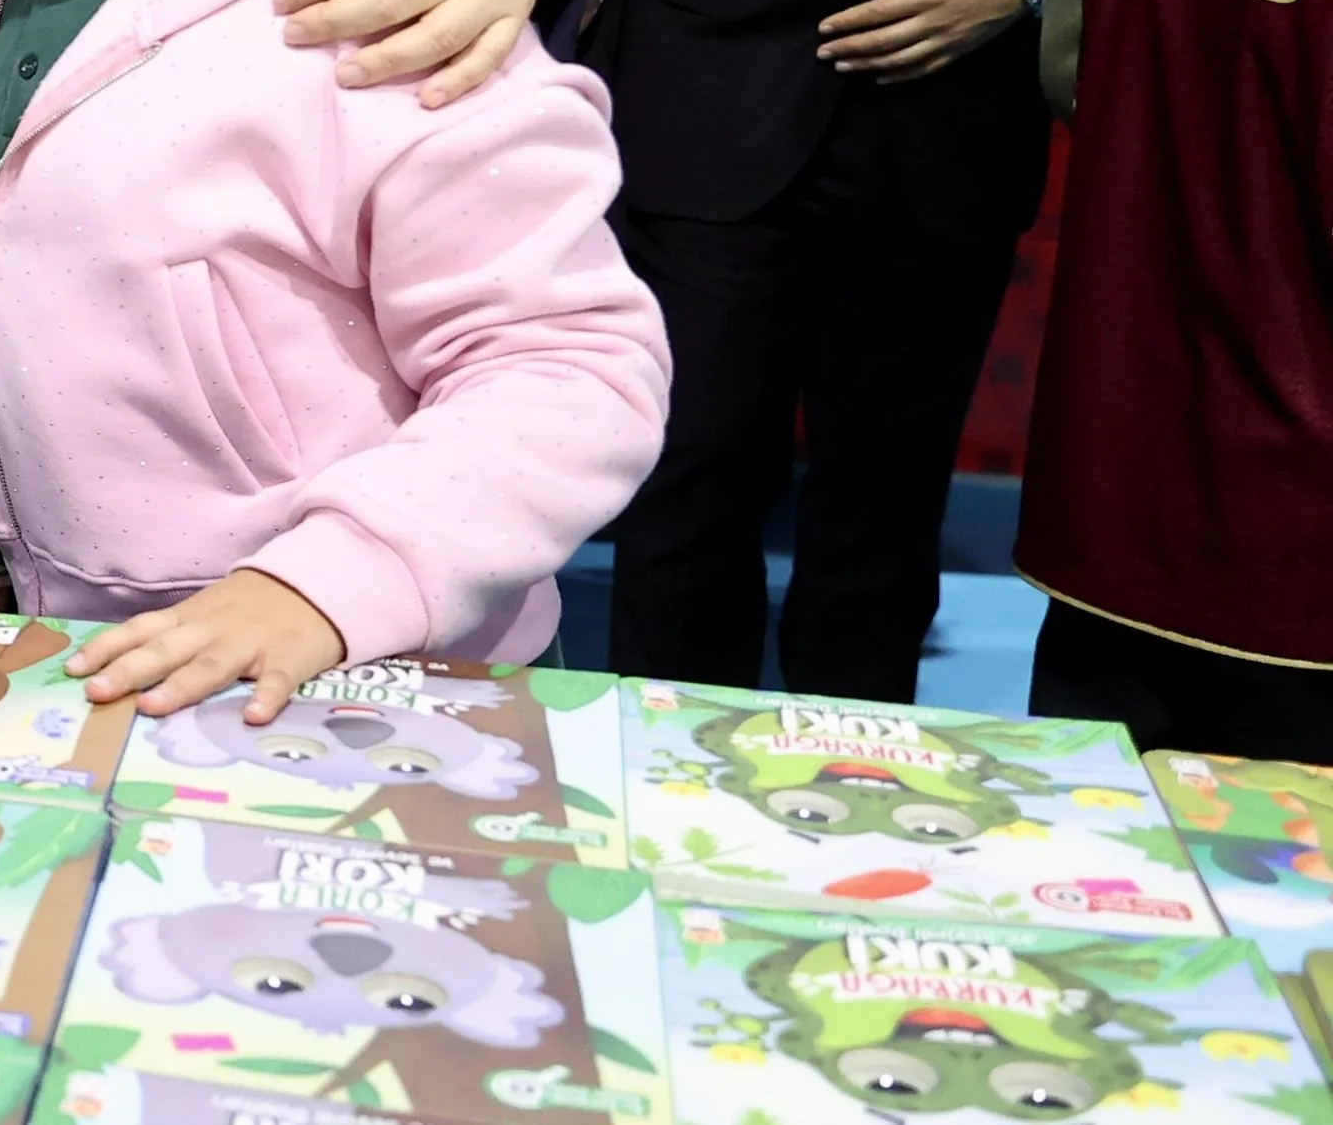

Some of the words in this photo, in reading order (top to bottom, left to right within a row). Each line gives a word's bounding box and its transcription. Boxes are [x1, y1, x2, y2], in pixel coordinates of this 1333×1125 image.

[317, 664, 425, 690] KOR
[297, 681, 416, 709] KOALA
[277, 885, 416, 925] KOALA
